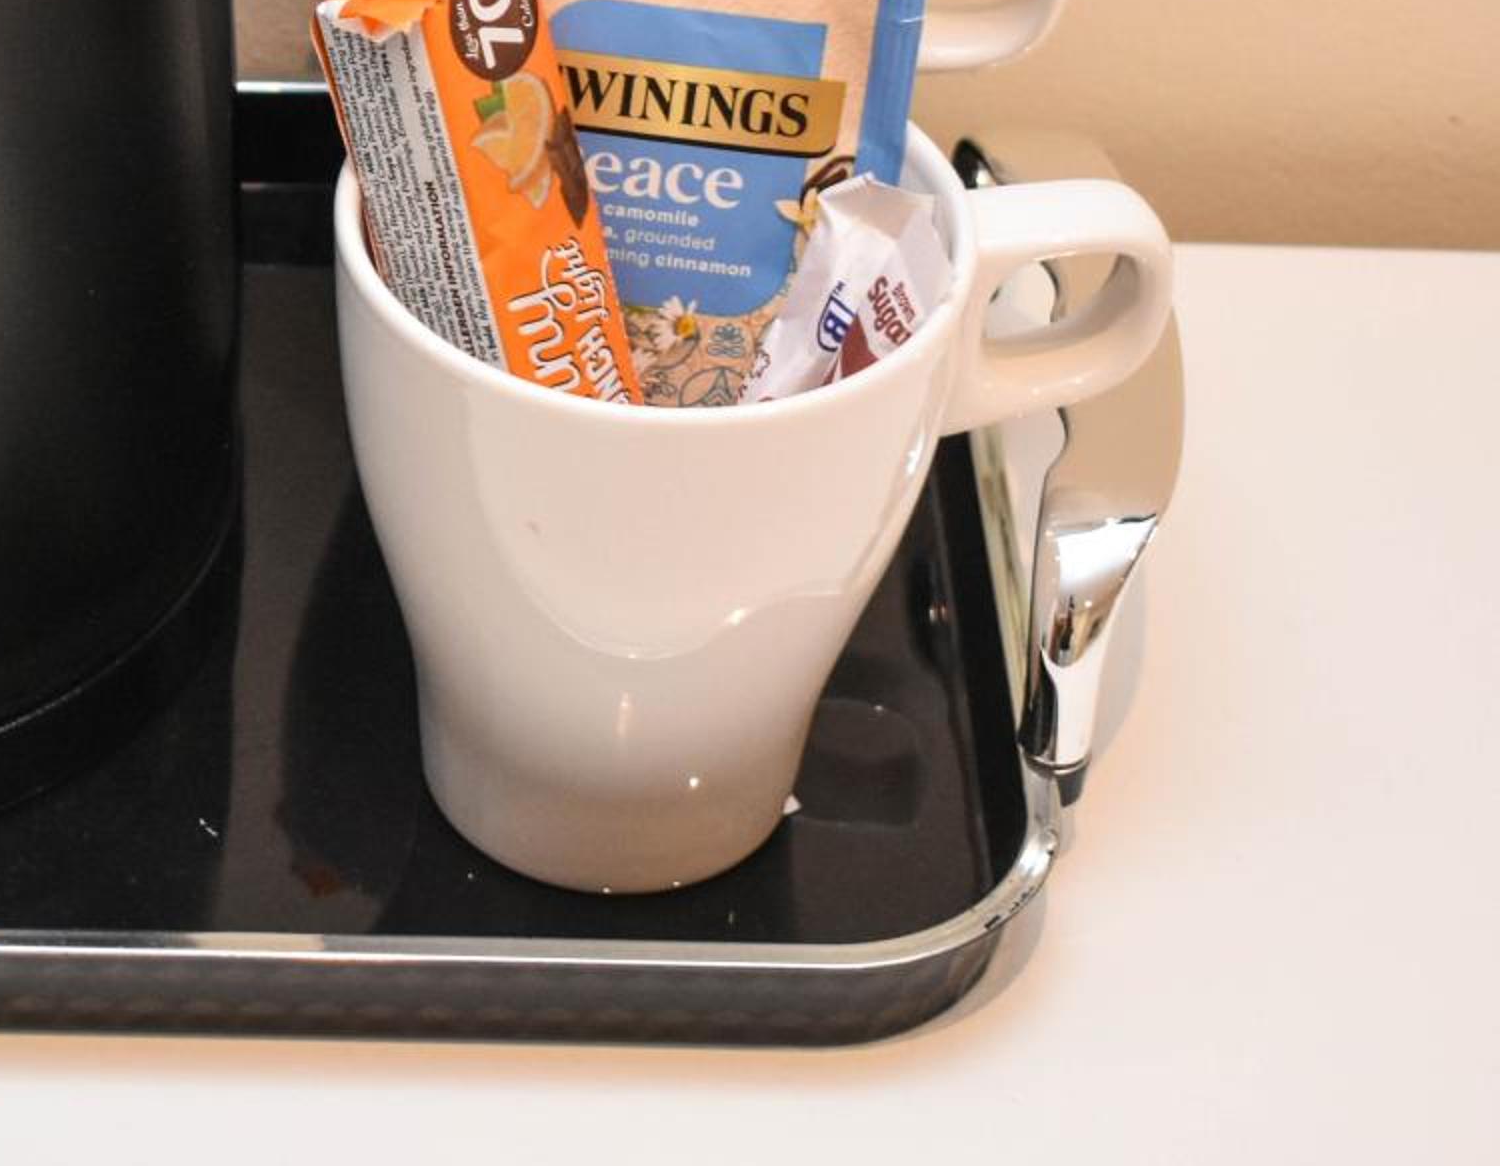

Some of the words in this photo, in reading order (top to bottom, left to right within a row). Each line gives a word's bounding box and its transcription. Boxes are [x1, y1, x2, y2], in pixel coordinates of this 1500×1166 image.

[559, 65, 810, 138] WININGS
[580, 146, 743, 209] eace
[422, 179, 459, 286] INFORMATION
[603, 204, 699, 227] camomile
[625, 228, 715, 251] grounded
[654, 254, 752, 277] cinnamon
